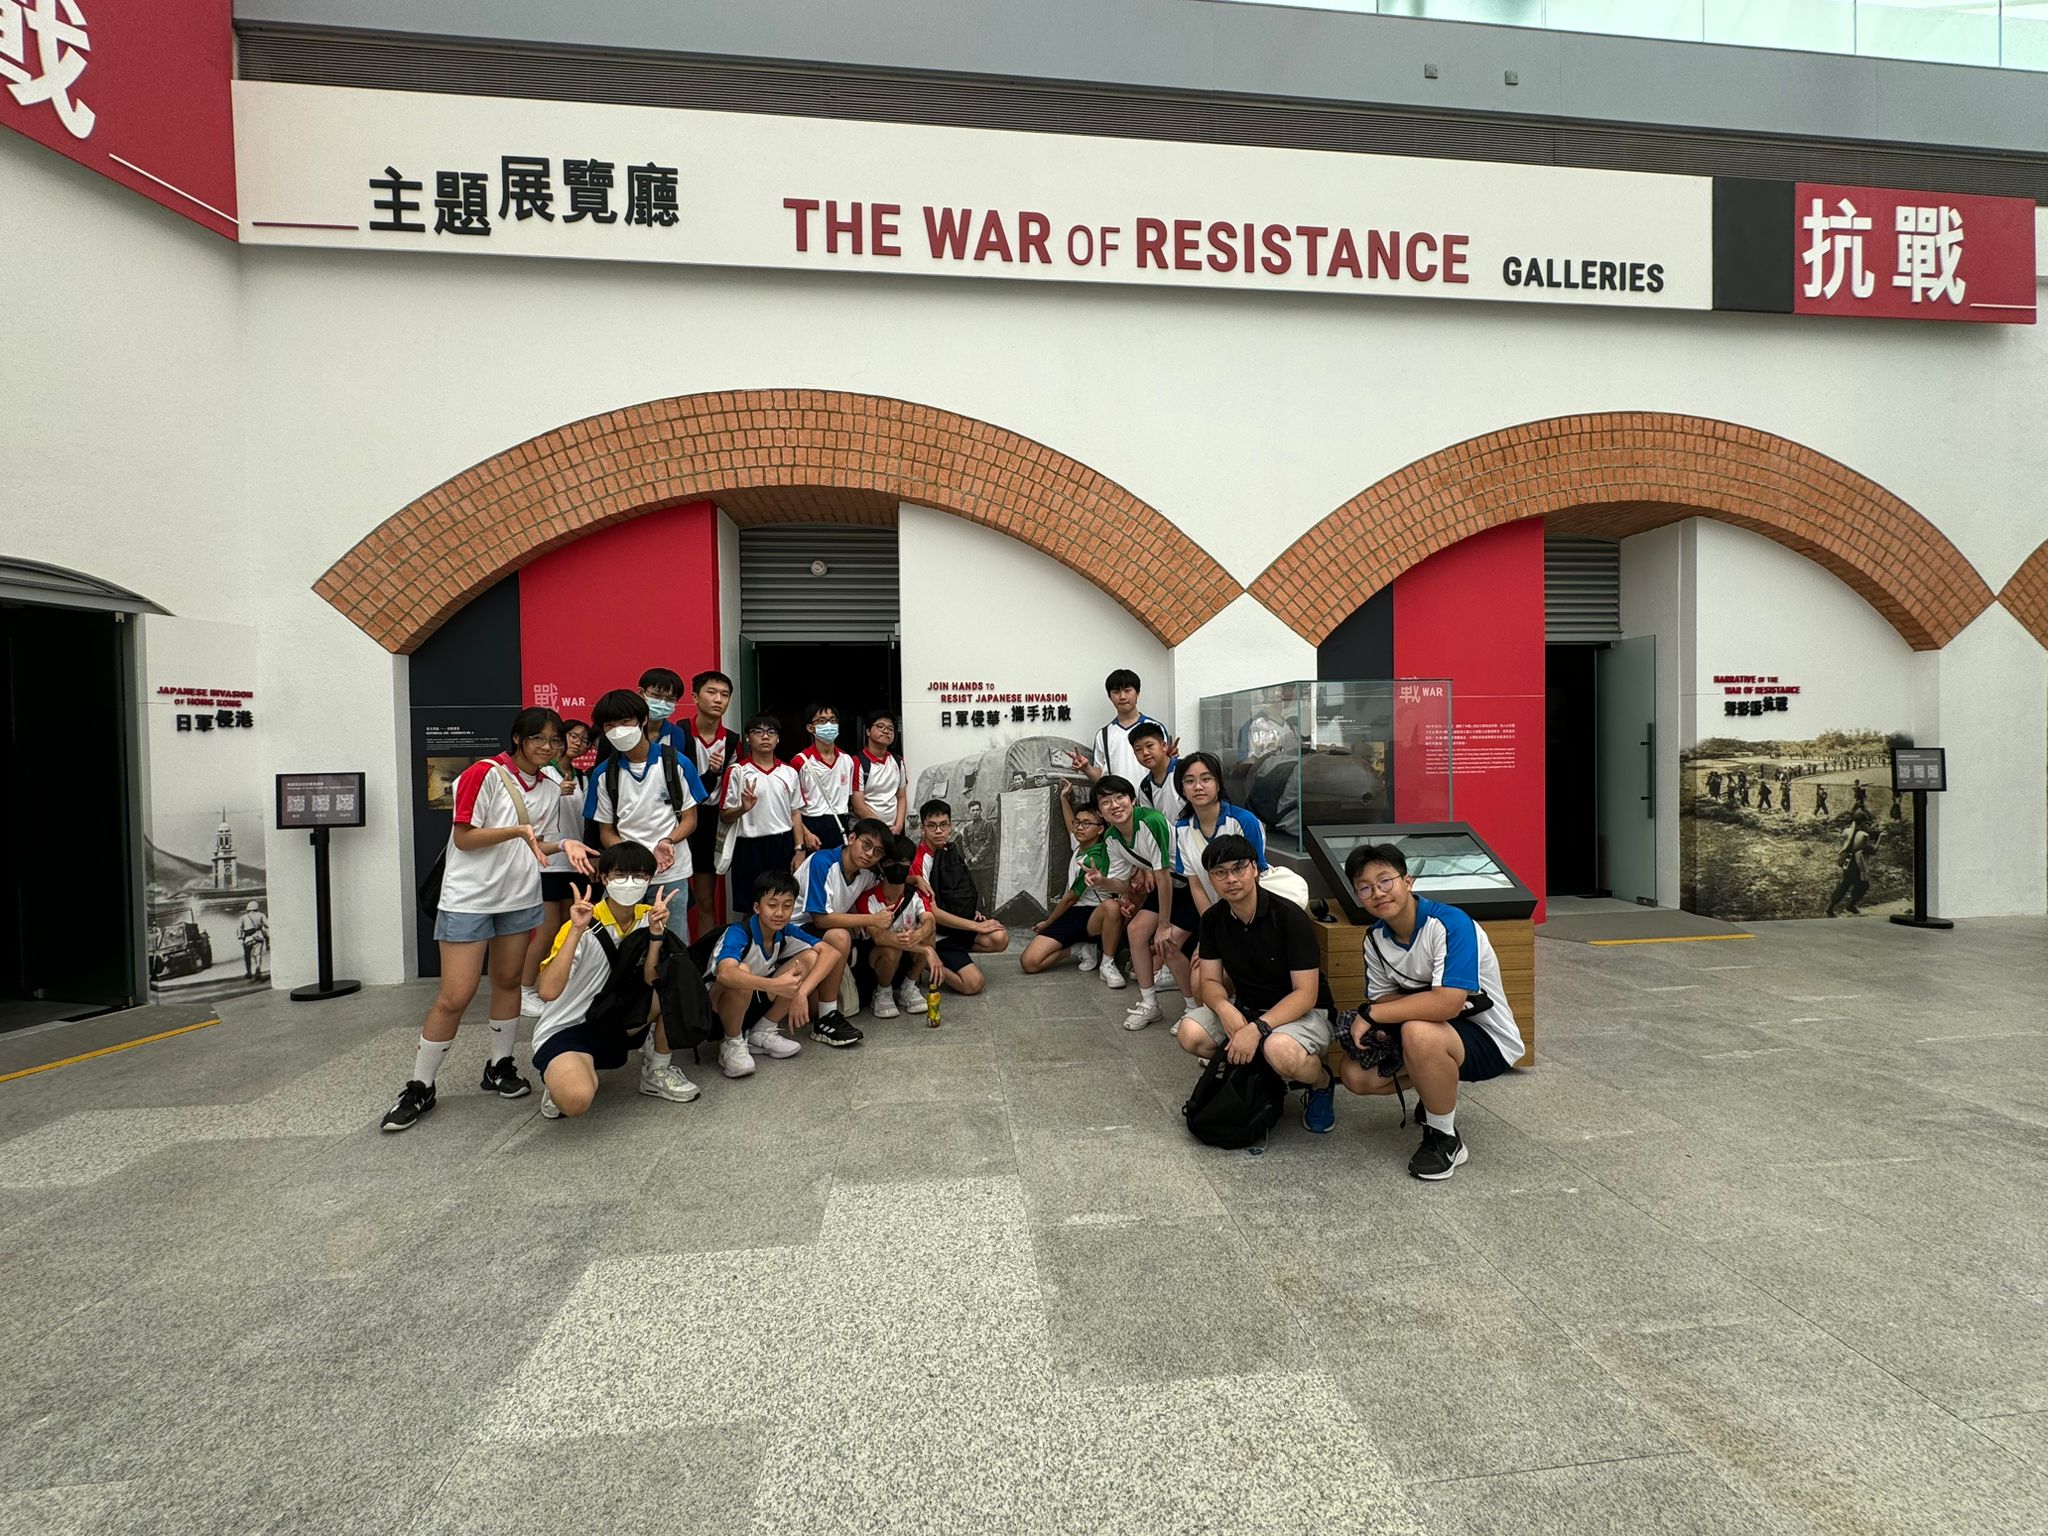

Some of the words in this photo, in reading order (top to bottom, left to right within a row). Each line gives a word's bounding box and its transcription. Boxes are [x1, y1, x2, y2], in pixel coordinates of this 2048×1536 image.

[369, 155, 680, 237] 主題展覽廳
[783, 197, 902, 257] THE
[923, 205, 1052, 264] WAR
[1067, 224, 1121, 267] OF
[1135, 216, 1469, 284] RESISTANCE
[1502, 256, 1665, 294] GALLERIES
[1801, 197, 1966, 306] 抗戰
[1713, 675, 1757, 684] NARRATIVE
[927, 681, 949, 691] JOIN
[952, 681, 984, 691] HANDS
[986, 682, 995, 691] TO
[1422, 686, 1444, 697] WAR
[1724, 686, 1742, 695] WAR
[1743, 686, 1754, 694] OF
[1755, 686, 1801, 694] RESISTANCE
[157, 686, 208, 697] JAPANESE
[210, 689, 253, 699] INVASION
[940, 693, 973, 703] RESIST
[975, 693, 1022, 703] JAPANESE
[1025, 693, 1068, 703] INVASION
[174, 698, 185, 706] OF
[186, 698, 214, 707] HONG
[216, 699, 242, 708] KONG
[561, 696, 586, 707] WAR
[176, 709, 254, 733] 日軍侵港
